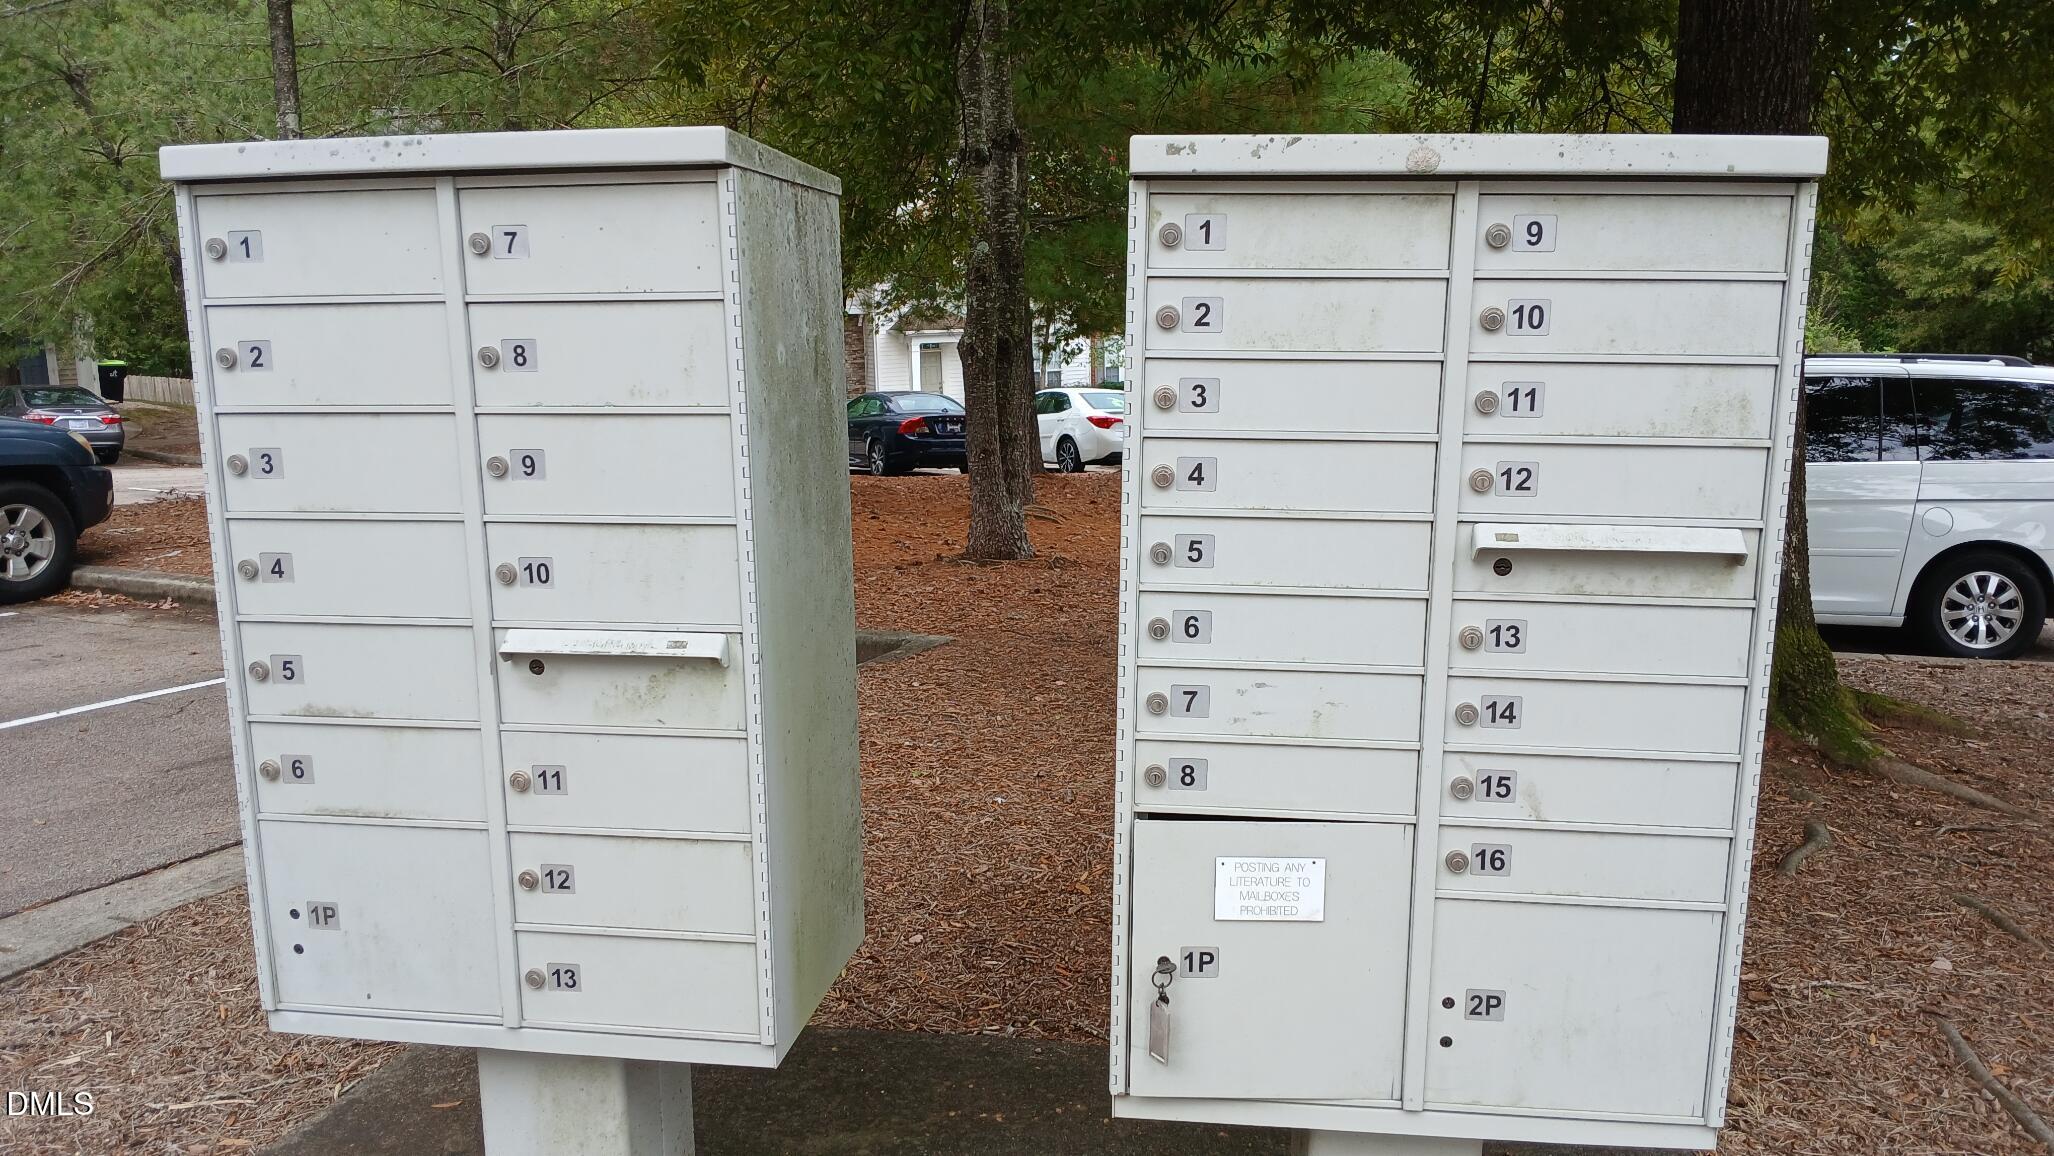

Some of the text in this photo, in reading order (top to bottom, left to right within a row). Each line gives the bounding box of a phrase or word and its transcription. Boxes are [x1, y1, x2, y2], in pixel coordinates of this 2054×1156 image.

[503, 231, 518, 254] 7
[1199, 219, 1211, 245] 1
[1526, 220, 1543, 247] 9
[239, 236, 251, 259] 1
[1193, 302, 1211, 327] 2
[1512, 304, 1545, 330] 10
[249, 346, 264, 368] 2
[513, 344, 528, 367] 8
[1191, 383, 1207, 408] 3
[1507, 387, 1537, 412] 11
[260, 453, 274, 475] 3
[521, 454, 536, 477] 9
[1187, 462, 1205, 486] 4
[1500, 467, 1532, 491] 12
[1187, 539, 1203, 563] 5
[270, 557, 285, 579] 4
[523, 562, 550, 585] 10
[1184, 615, 1200, 639] 6
[1489, 624, 1521, 649] 13
[282, 660, 295, 681] 5
[1182, 690, 1198, 713] 7
[1485, 700, 1517, 724] 14
[291, 759, 305, 779] 6
[537, 769, 561, 791] 11
[1180, 764, 1196, 787] 8
[1480, 775, 1512, 799] 15
[1234, 862, 1306, 873] POSTING ANY
[1475, 848, 1506, 872] 16
[544, 869, 571, 890] 12
[1229, 876, 1311, 888] LITERATURE TO
[1239, 891, 1300, 902] MAILBOXES
[310, 905, 336, 926] 1P
[1239, 905, 1299, 916] PROHIBITED
[1183, 951, 1215, 973] 1P
[551, 968, 577, 989] 13
[1468, 994, 1502, 1016] 2P
